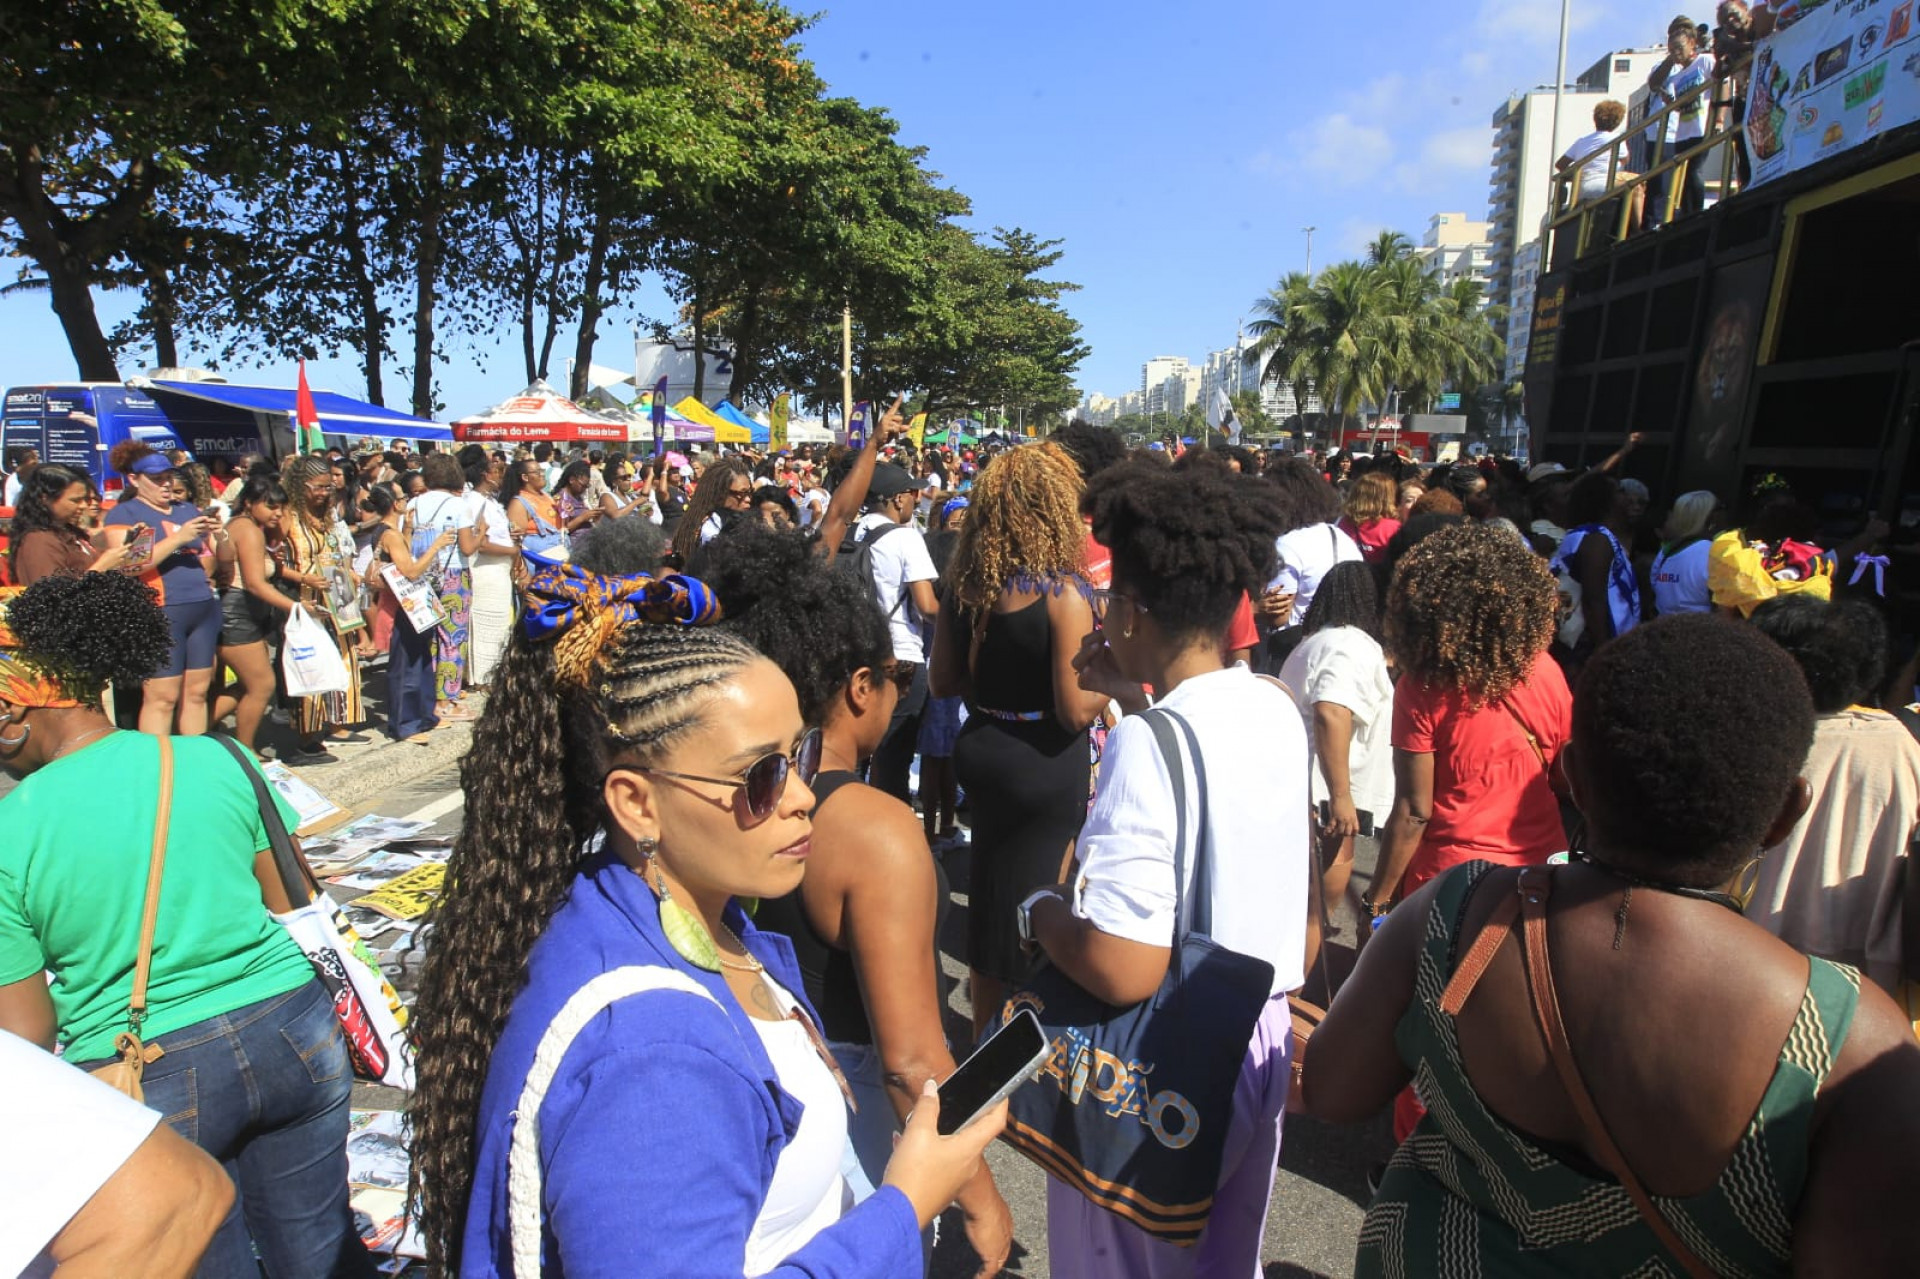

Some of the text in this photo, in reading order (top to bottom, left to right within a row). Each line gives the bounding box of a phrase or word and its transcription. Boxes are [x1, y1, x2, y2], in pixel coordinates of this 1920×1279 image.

[466, 427, 550, 437] Farmácia do Leme
[578, 427, 600, 437] Farmácia
[607, 429, 621, 437] Leme
